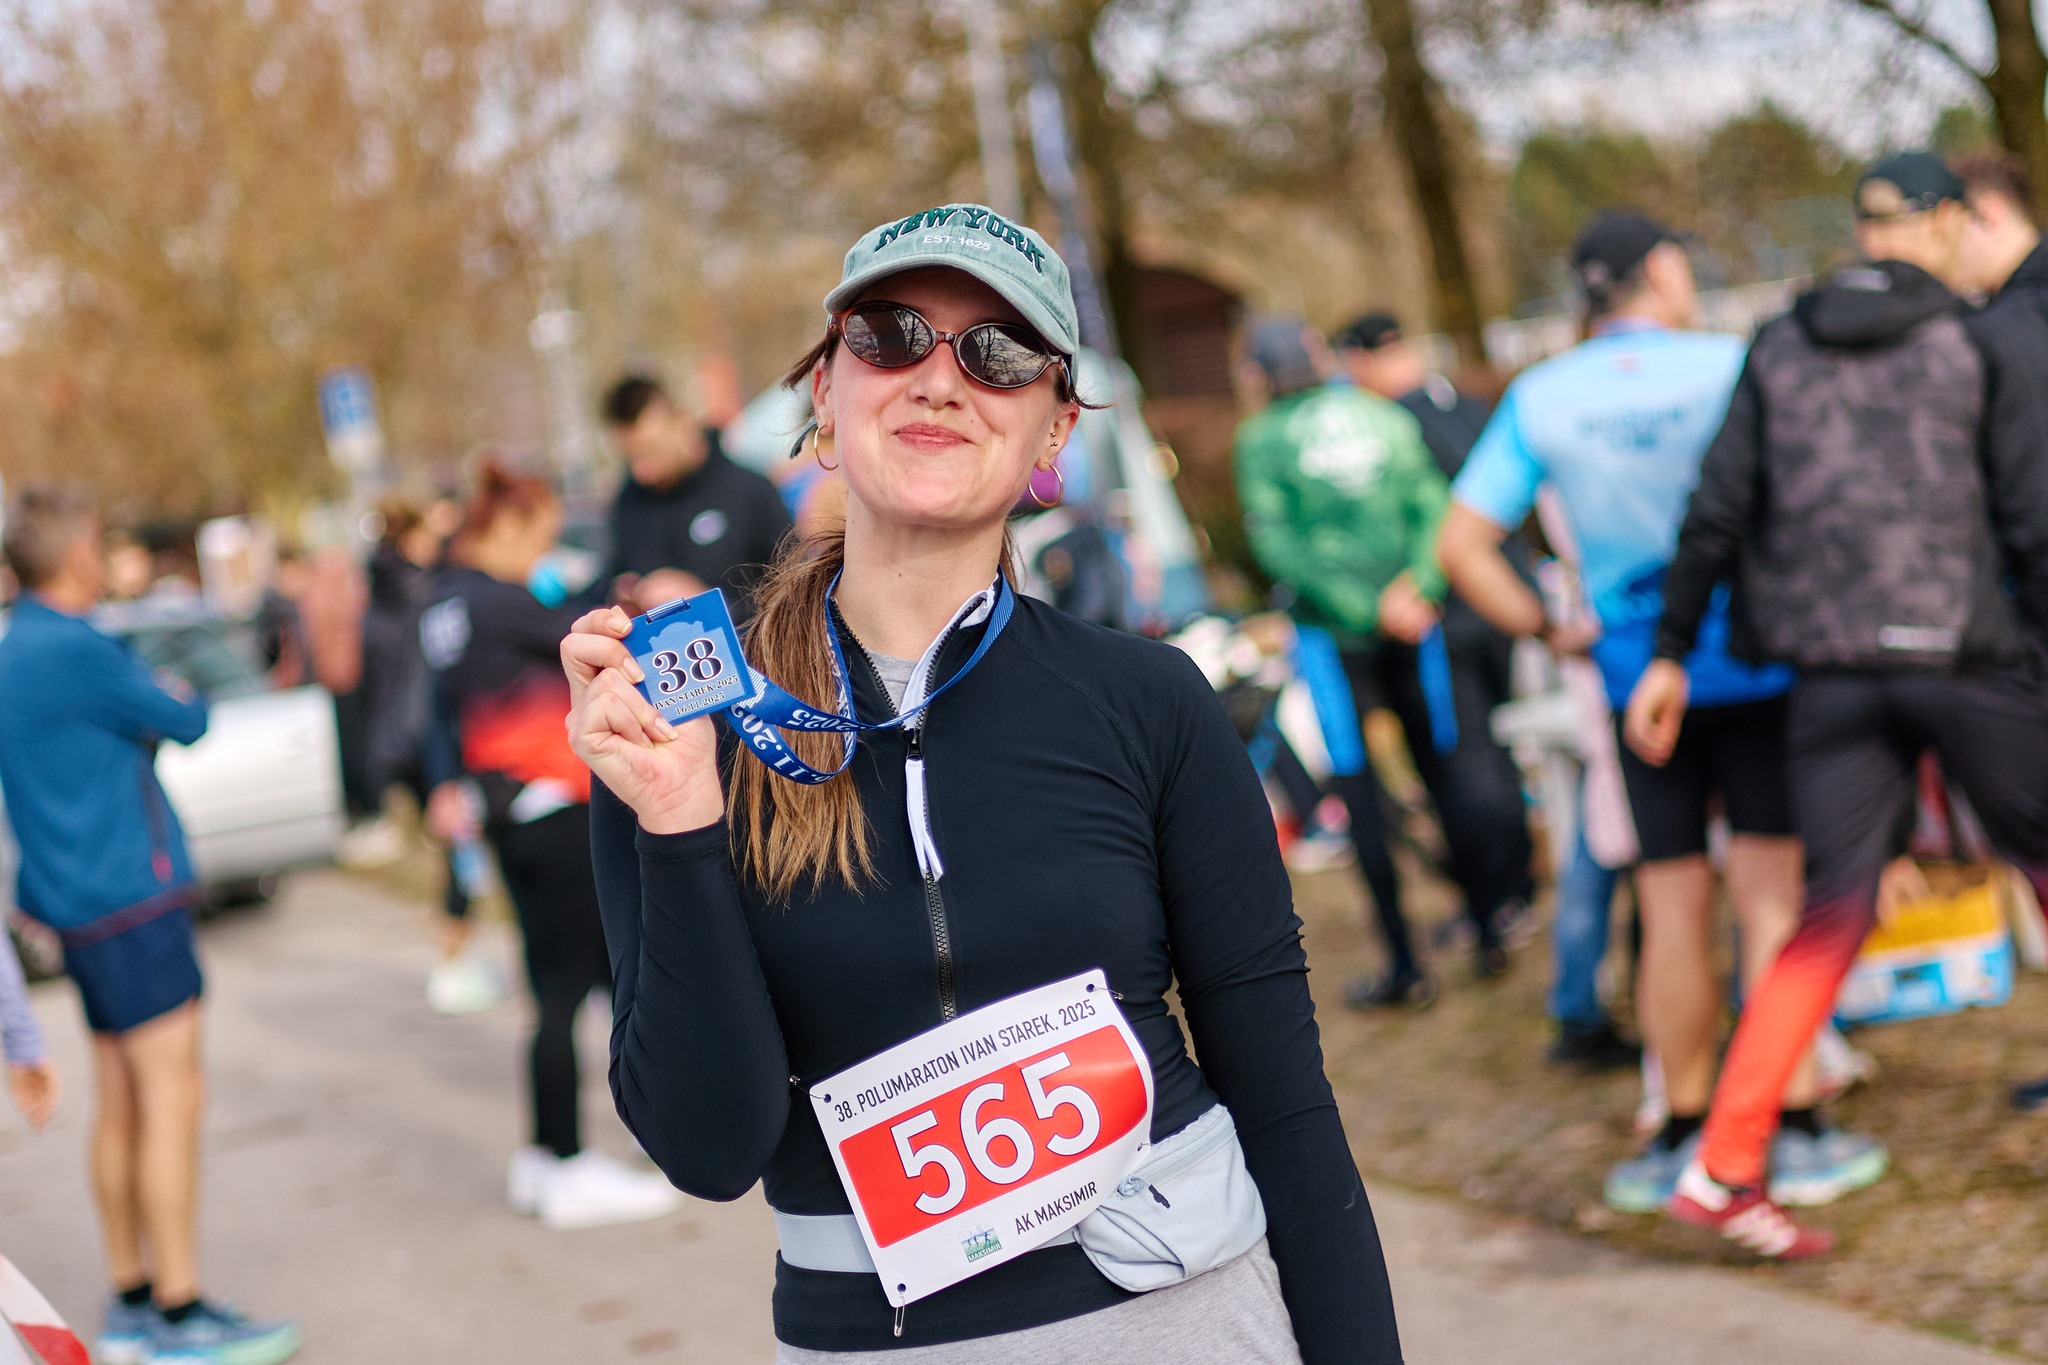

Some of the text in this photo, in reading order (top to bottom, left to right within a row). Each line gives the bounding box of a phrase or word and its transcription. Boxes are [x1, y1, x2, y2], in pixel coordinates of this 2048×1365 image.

[874, 206, 1046, 275] NEW YORK
[923, 235, 992, 251] EST. 1625
[652, 638, 723, 693] 38
[654, 675, 739, 710] IVAN STAREK 2025
[676, 692, 726, 716] 16.11.2025
[834, 999, 1096, 1123] 38. POLUMARATON IVAN STAREK, 2025
[890, 1051, 1101, 1215] 565
[1014, 1180, 1098, 1235] AK MAKSIMIR
[967, 1243, 1003, 1262] MAKSIMIR
